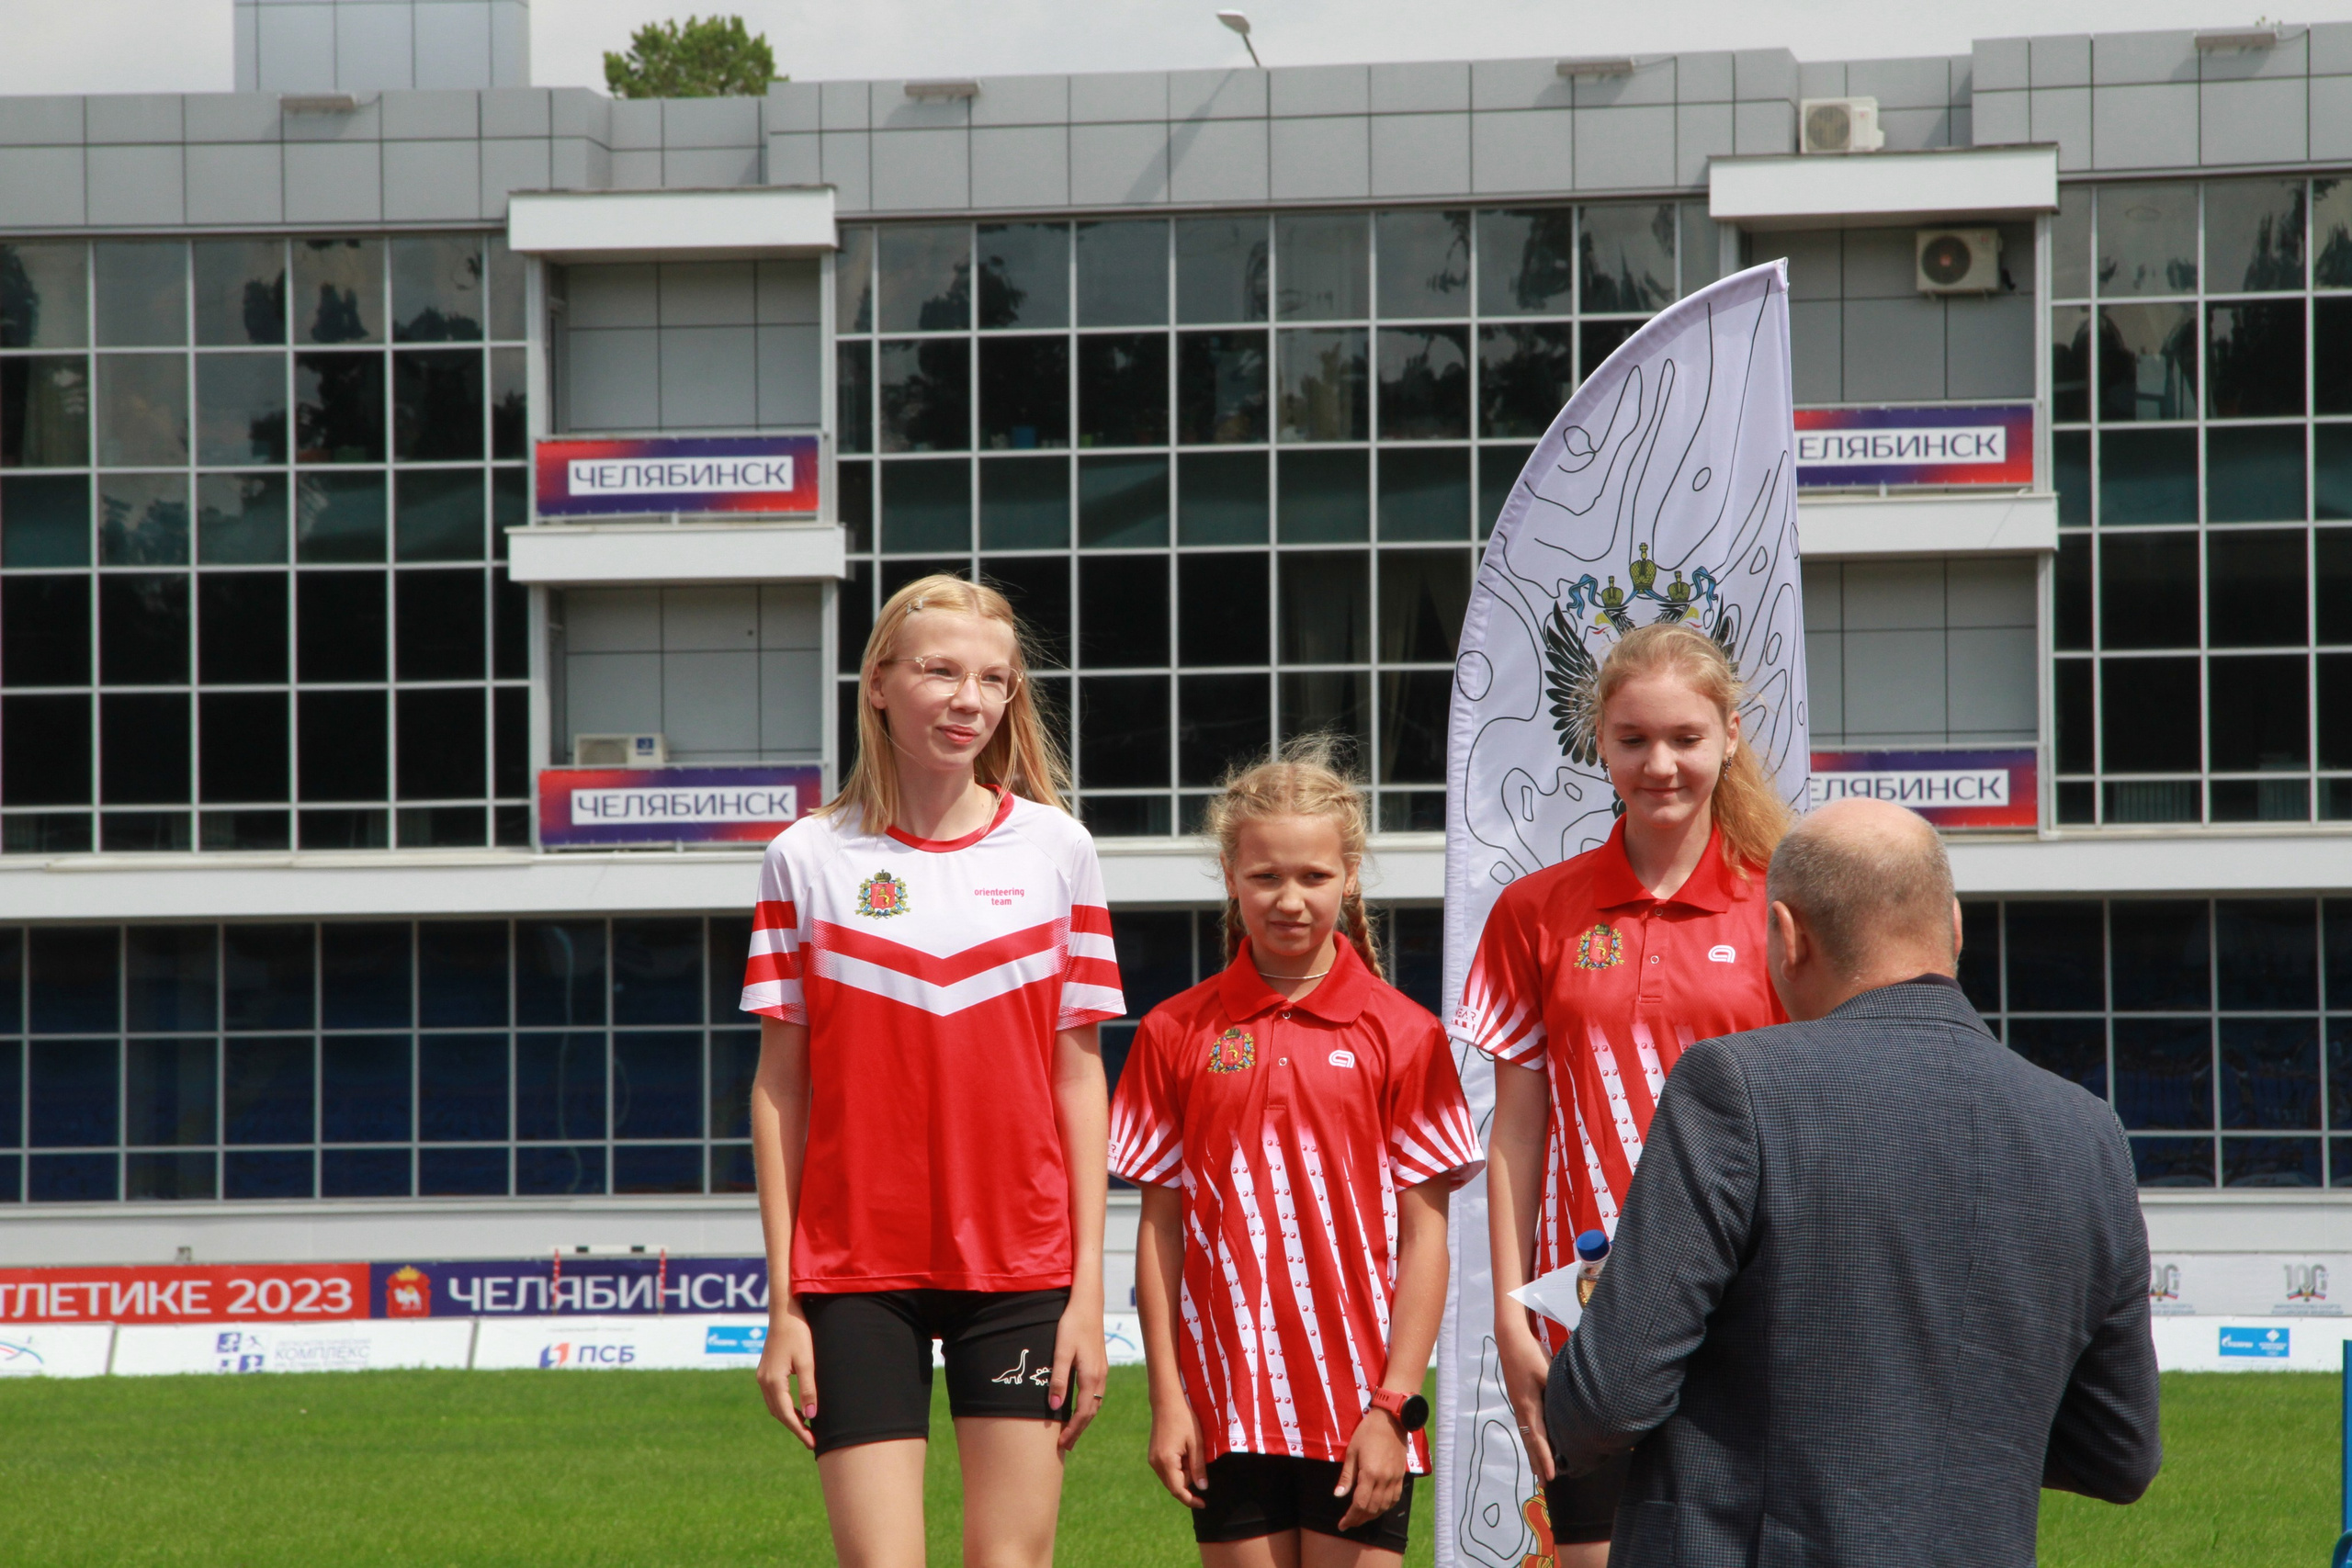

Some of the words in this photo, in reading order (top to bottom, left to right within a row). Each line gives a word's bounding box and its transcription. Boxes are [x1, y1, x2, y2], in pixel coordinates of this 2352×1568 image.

[1799, 433, 1998, 459] ЕЛЯБИНСК
[574, 461, 786, 489] ЧЕЛЯБИНСК
[1811, 775, 2002, 801] ЕЛЯБИНСК
[577, 791, 790, 818] ЧЕЛЯБИНСК
[974, 887, 1024, 897] orienteering
[991, 897, 1012, 906] team
[226, 1278, 354, 1314] 2023
[275, 1345, 370, 1360] КОМПЛЕКС
[578, 1345, 636, 1364] ПСБ
